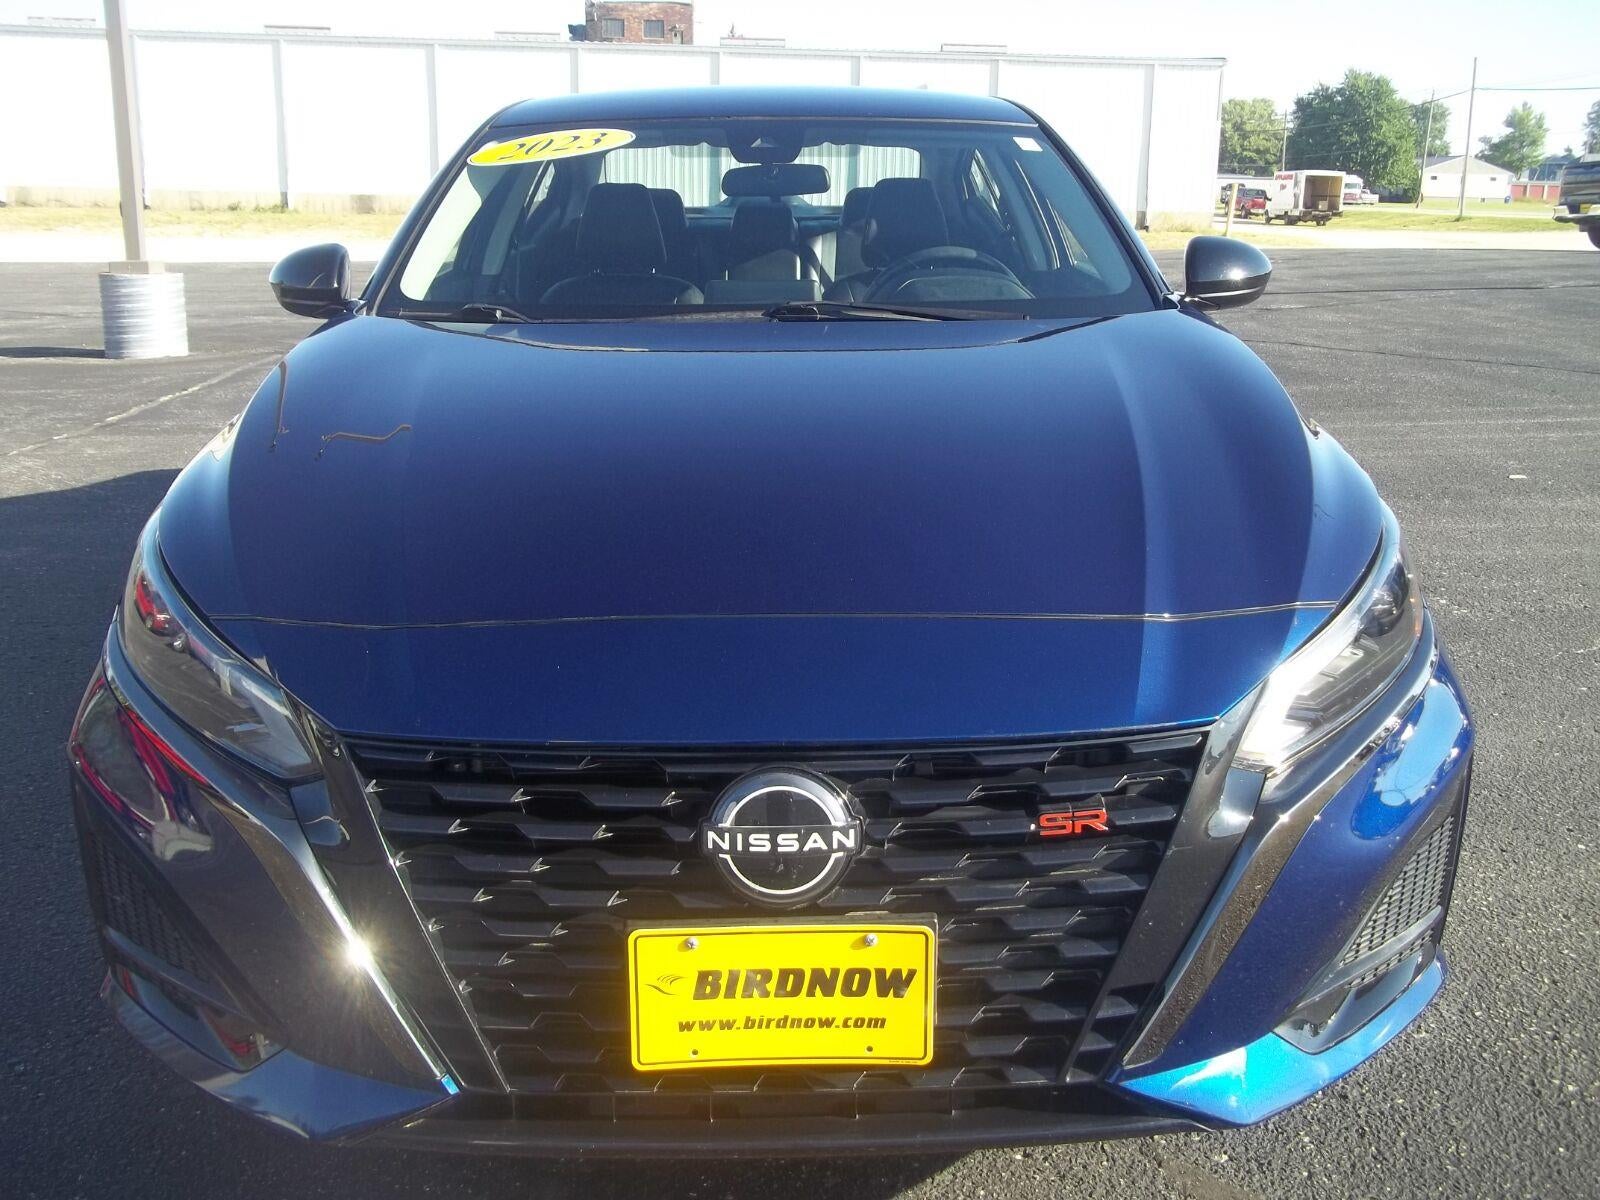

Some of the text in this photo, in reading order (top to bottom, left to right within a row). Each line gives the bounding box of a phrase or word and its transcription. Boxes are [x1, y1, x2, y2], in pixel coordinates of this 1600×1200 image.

[498, 132, 608, 160] 2023
[1039, 808, 1108, 836] SR
[707, 829, 855, 852] NISSAN
[693, 967, 917, 1000] BIRDNOW
[678, 1015, 886, 1032] www.birdnow.com
